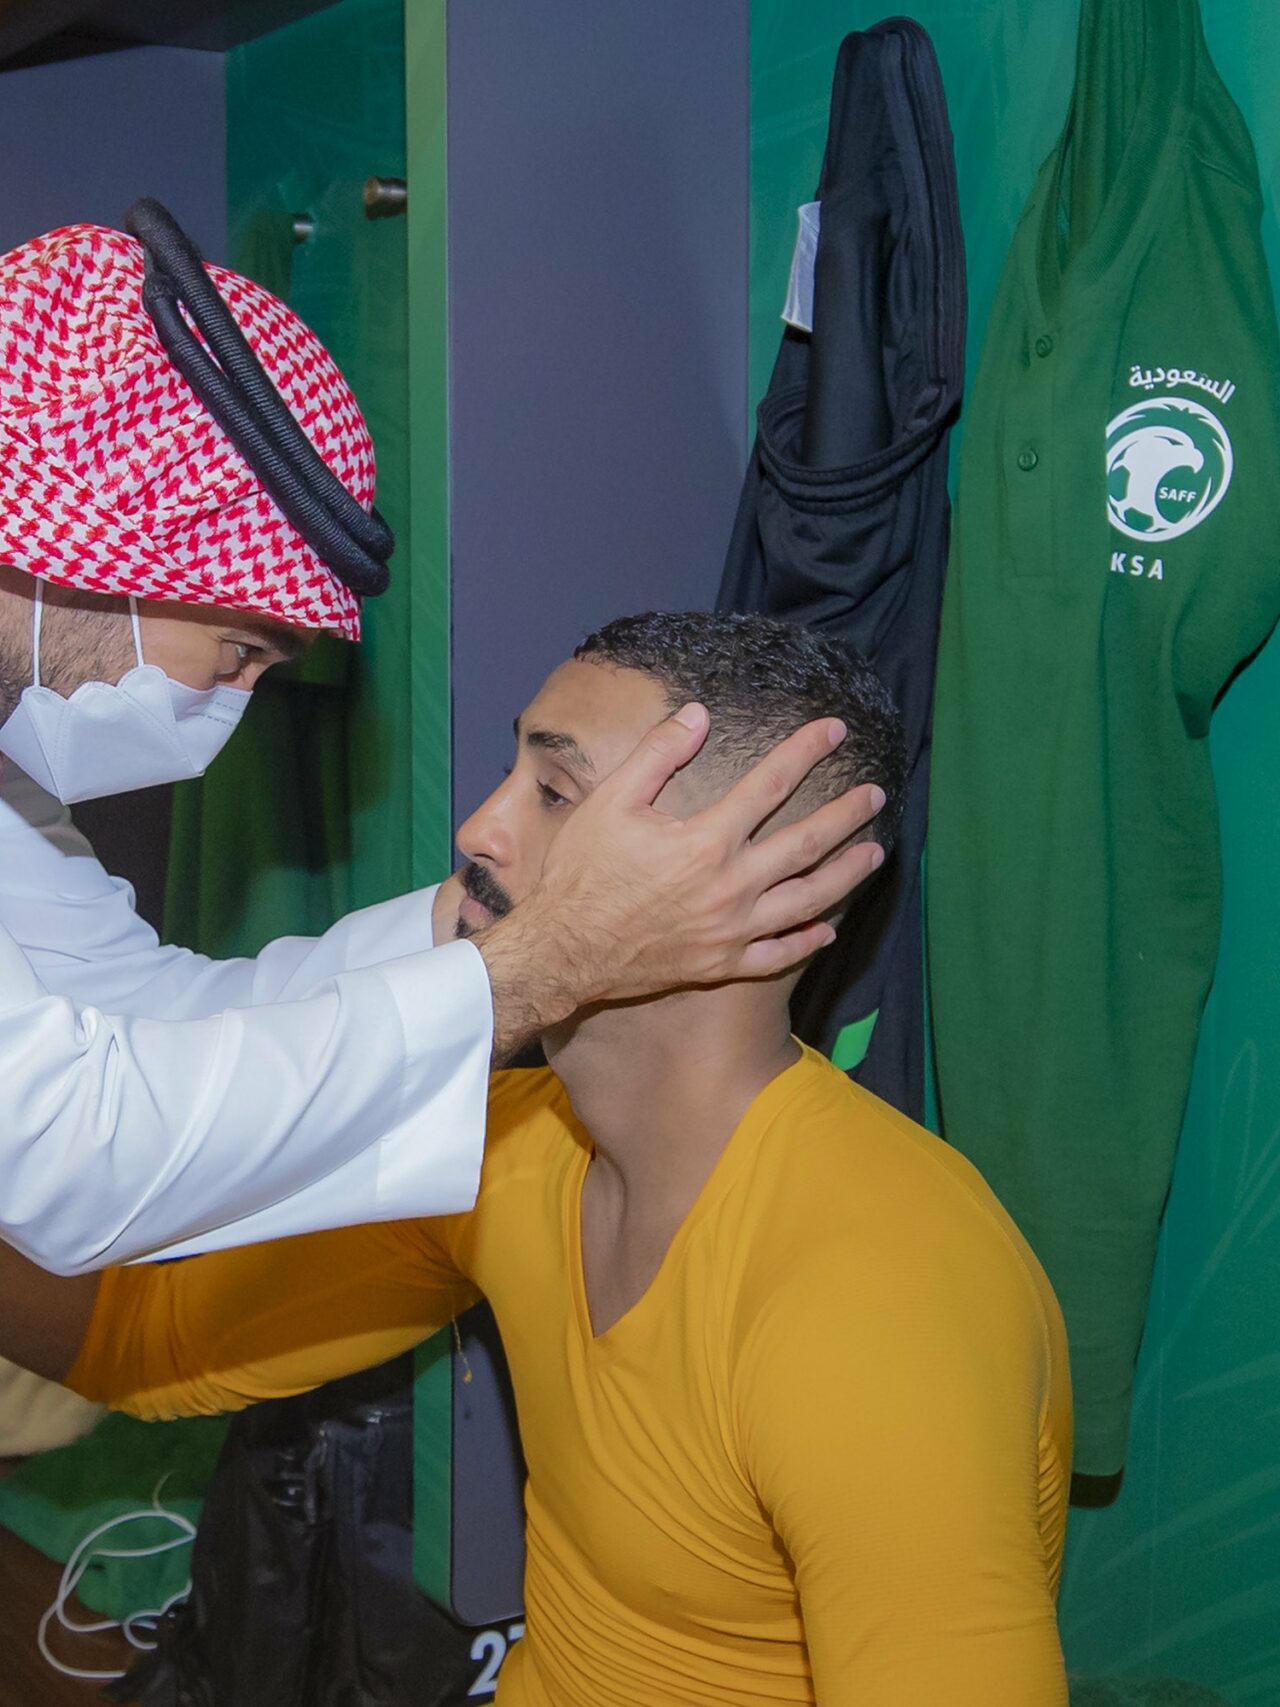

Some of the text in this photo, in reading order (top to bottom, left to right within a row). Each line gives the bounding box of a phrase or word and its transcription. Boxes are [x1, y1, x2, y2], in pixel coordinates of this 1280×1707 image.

[1129, 365, 1236, 404] السعودية
[1158, 486, 1197, 503] SAFF
[1110, 552, 1164, 581] KSA
[467, 1623, 526, 1696] 2
